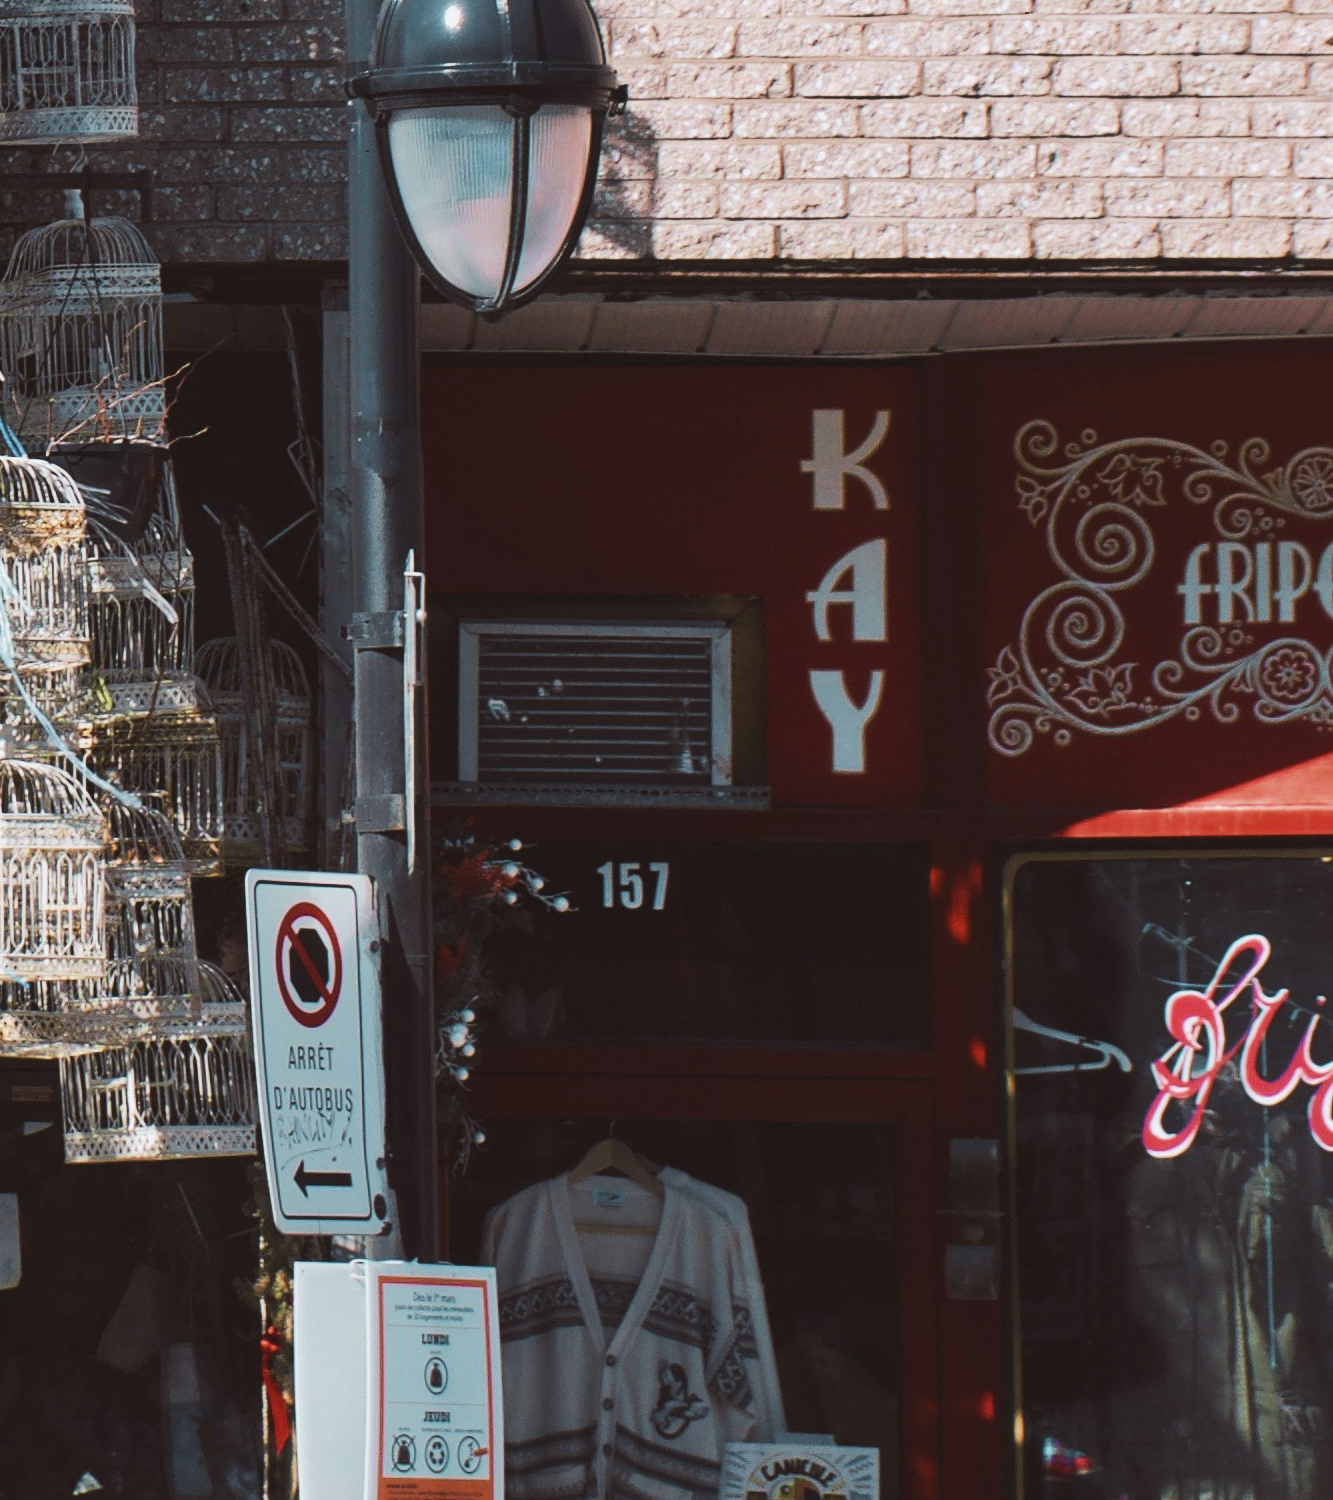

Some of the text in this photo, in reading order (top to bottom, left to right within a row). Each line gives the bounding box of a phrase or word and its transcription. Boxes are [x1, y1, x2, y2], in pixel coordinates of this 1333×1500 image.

[800, 408, 893, 774] KAY
[597, 861, 671, 912] 157
[288, 1042, 334, 1070] ARRÊT
[274, 1086, 353, 1112] D'AUTOBUS
[421, 1334, 449, 1345] LUNDI
[424, 1411, 450, 1422] JEUDI
